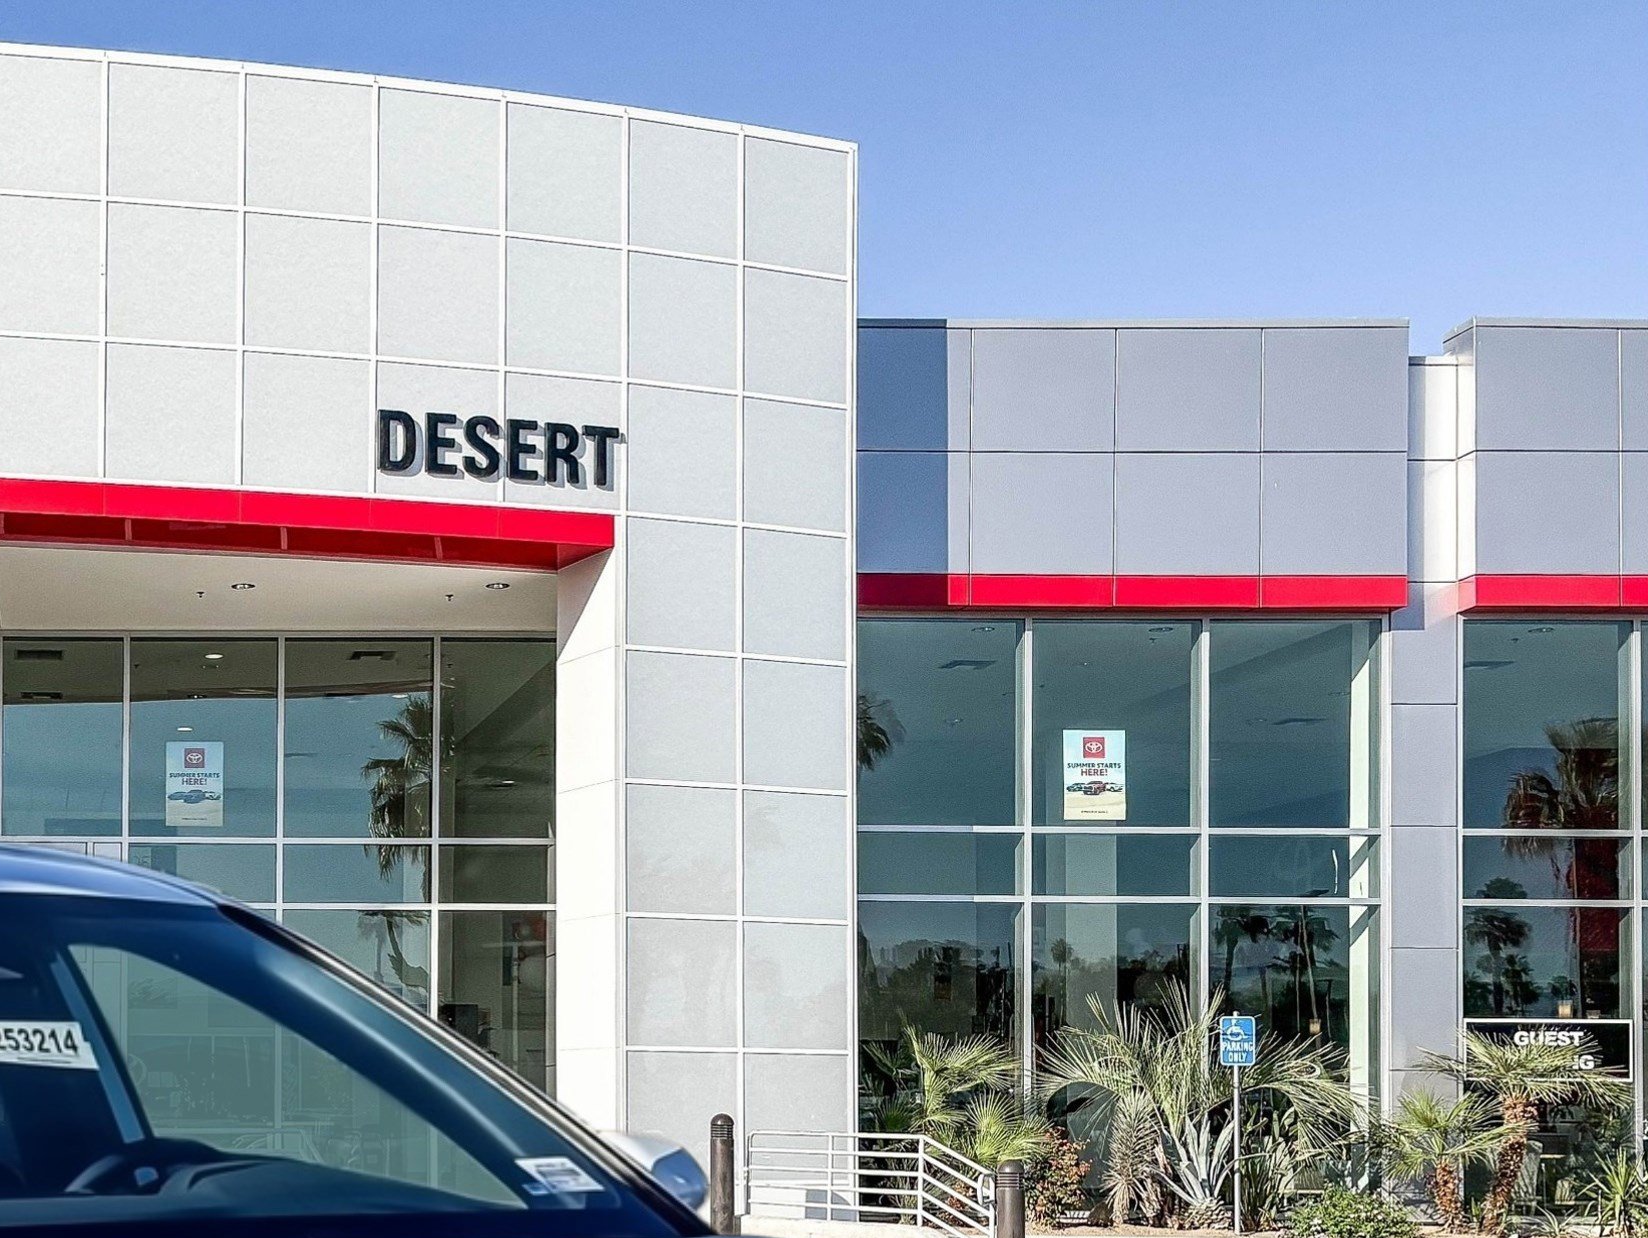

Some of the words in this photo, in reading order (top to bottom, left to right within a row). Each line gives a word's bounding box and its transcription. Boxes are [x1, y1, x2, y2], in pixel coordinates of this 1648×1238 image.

[377, 409, 620, 486] DESERT
[1080, 768, 1107, 777] HERE!
[181, 778, 207, 786] HERE!
[1514, 1030, 1584, 1047] GUEST
[1222, 1041, 1253, 1052] PARKING
[1228, 1051, 1248, 1063] ONLY
